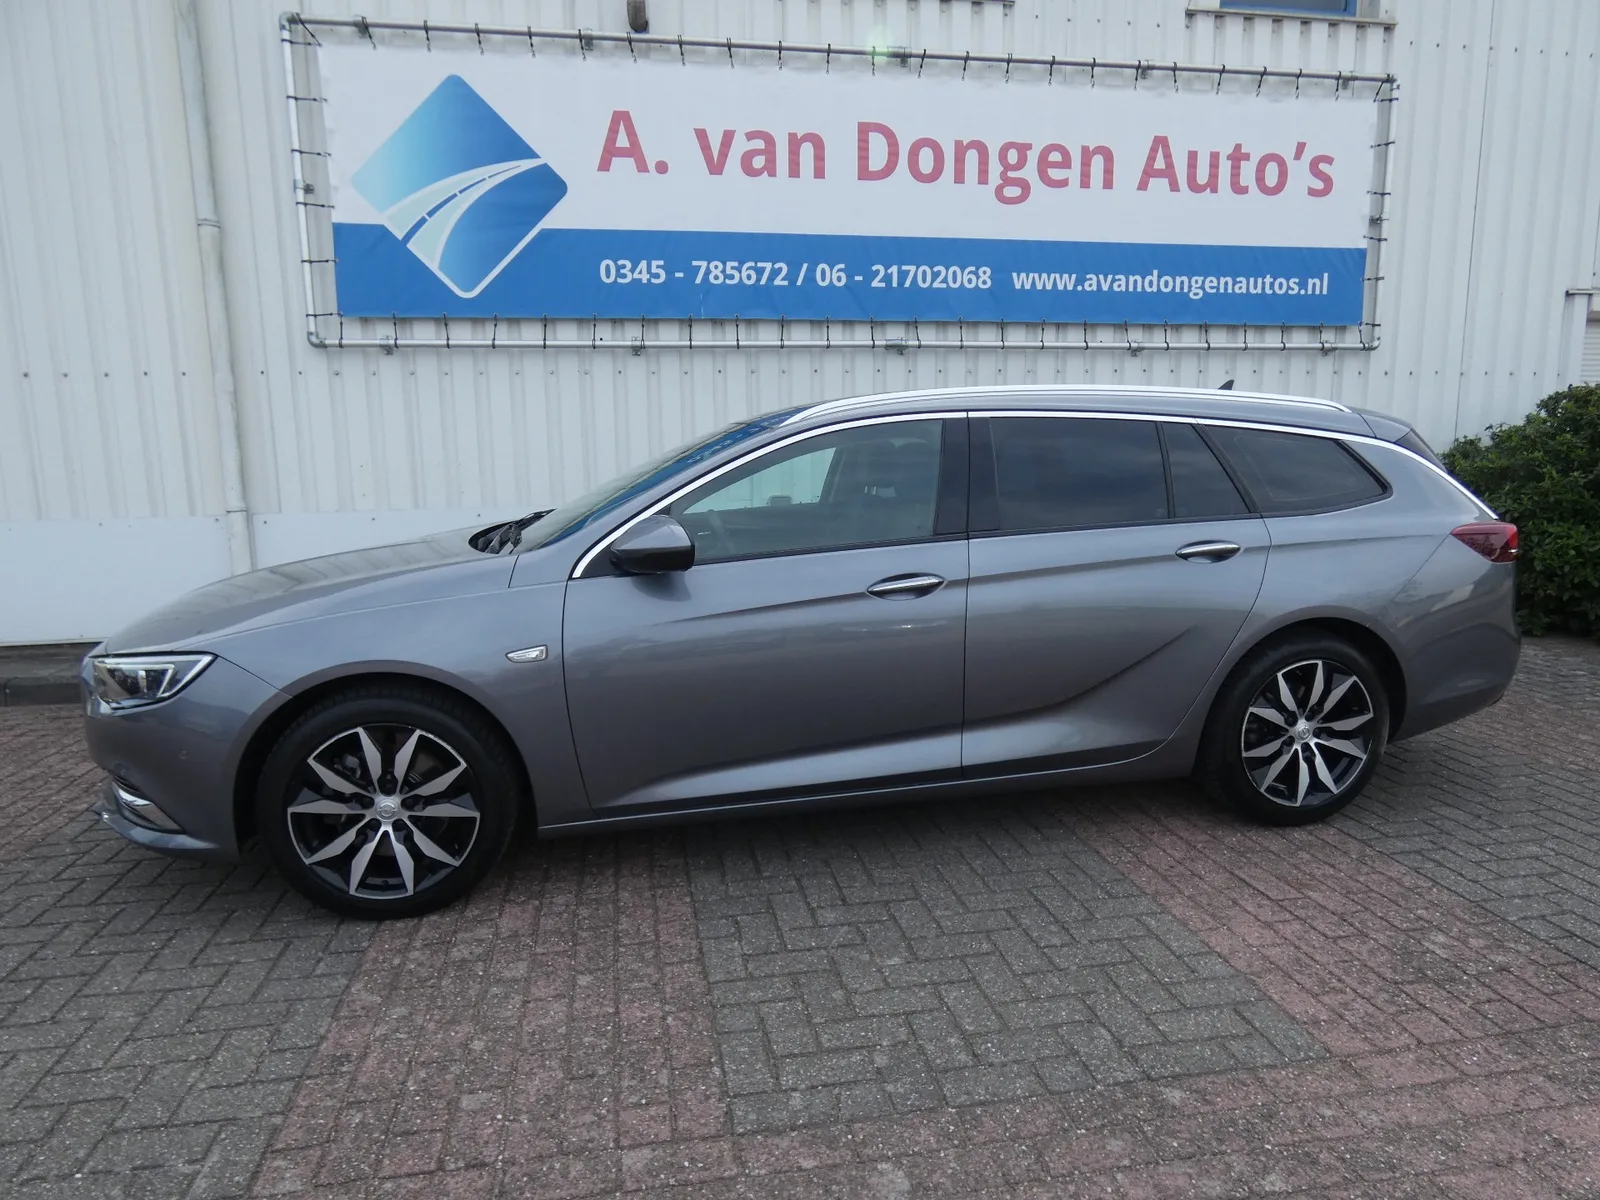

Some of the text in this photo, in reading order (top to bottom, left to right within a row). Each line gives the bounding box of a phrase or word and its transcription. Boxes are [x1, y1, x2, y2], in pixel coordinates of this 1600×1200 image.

[598, 110, 1333, 205] A. van Dongen Auto’s
[599, 259, 666, 284] 0345
[691, 260, 789, 286] 785672
[796, 262, 809, 286] /
[815, 262, 847, 287] 06
[871, 264, 992, 289] 21702068
[1011, 269, 1329, 300] www.avandongenautos.nl
